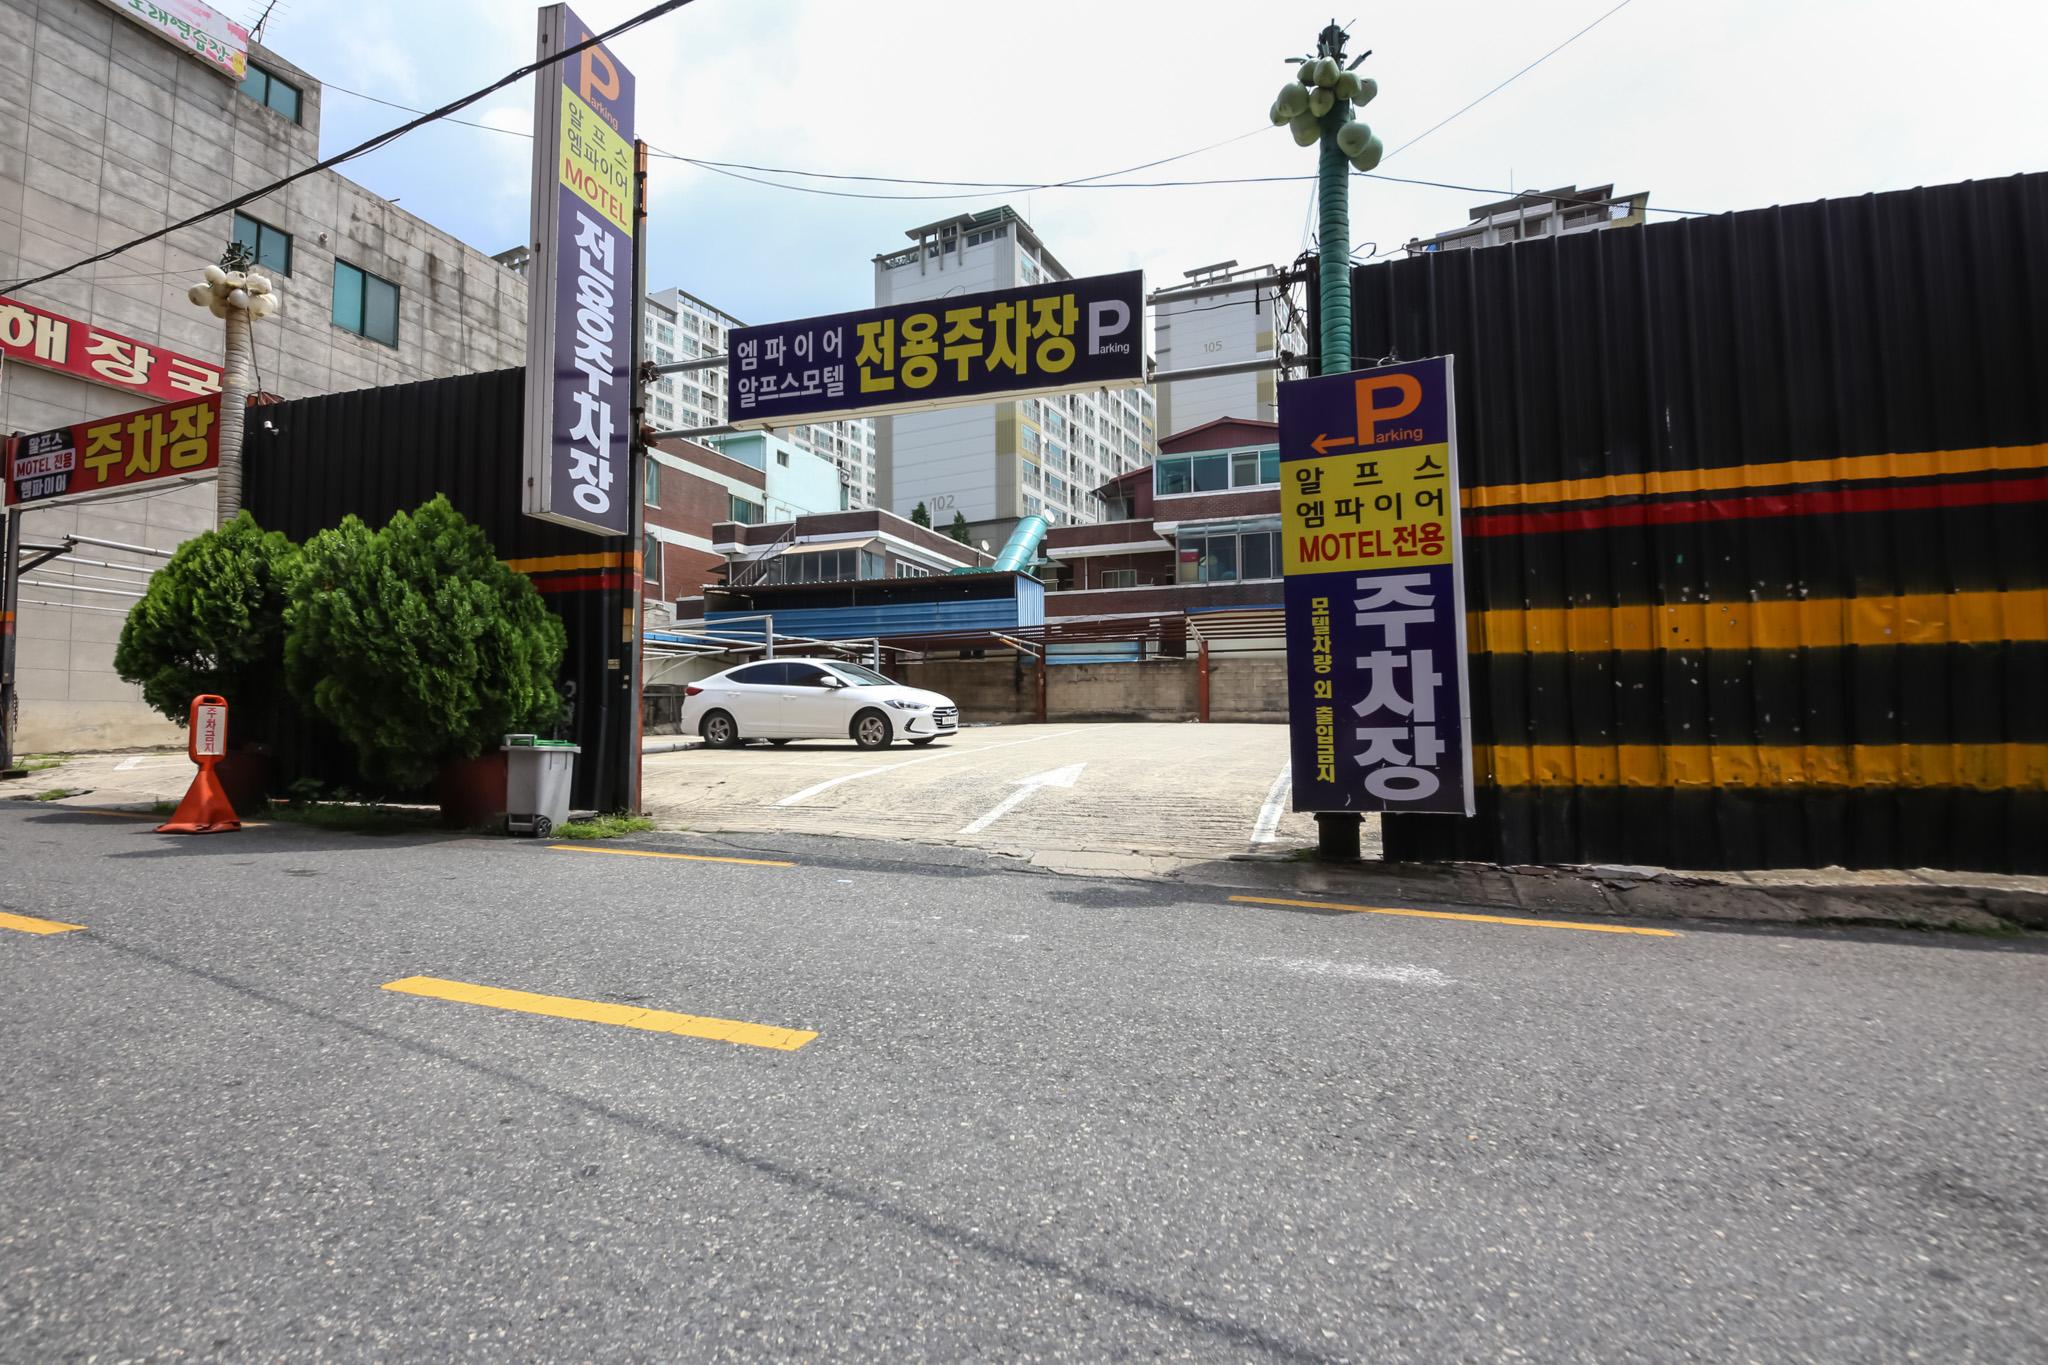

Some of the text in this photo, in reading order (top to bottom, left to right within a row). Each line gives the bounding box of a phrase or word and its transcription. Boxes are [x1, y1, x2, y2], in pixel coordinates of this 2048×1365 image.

[569, 102, 628, 170] 알프스
[568, 127, 628, 198] 엠파이어
[565, 157, 628, 226] MOTEL
[569, 210, 615, 514] 전용주차장
[737, 325, 844, 372] 엠파이어
[855, 293, 1079, 394] 전용주차장
[1203, 340, 1223, 353] 105
[737, 364, 844, 409] 알프스모텔
[16, 452, 73, 478] MOTEL 전용
[28, 432, 63, 455] 알프스
[83, 402, 215, 483] 주차장
[1295, 454, 1445, 496] 알프스
[930, 495, 955, 512] 102
[1296, 488, 1444, 529] 엠파이어
[1313, 680, 1333, 699] 외
[1352, 573, 1446, 801] 주차장
[205, 707, 217, 753] 주차금지
[1315, 706, 1336, 784] 출입금지
